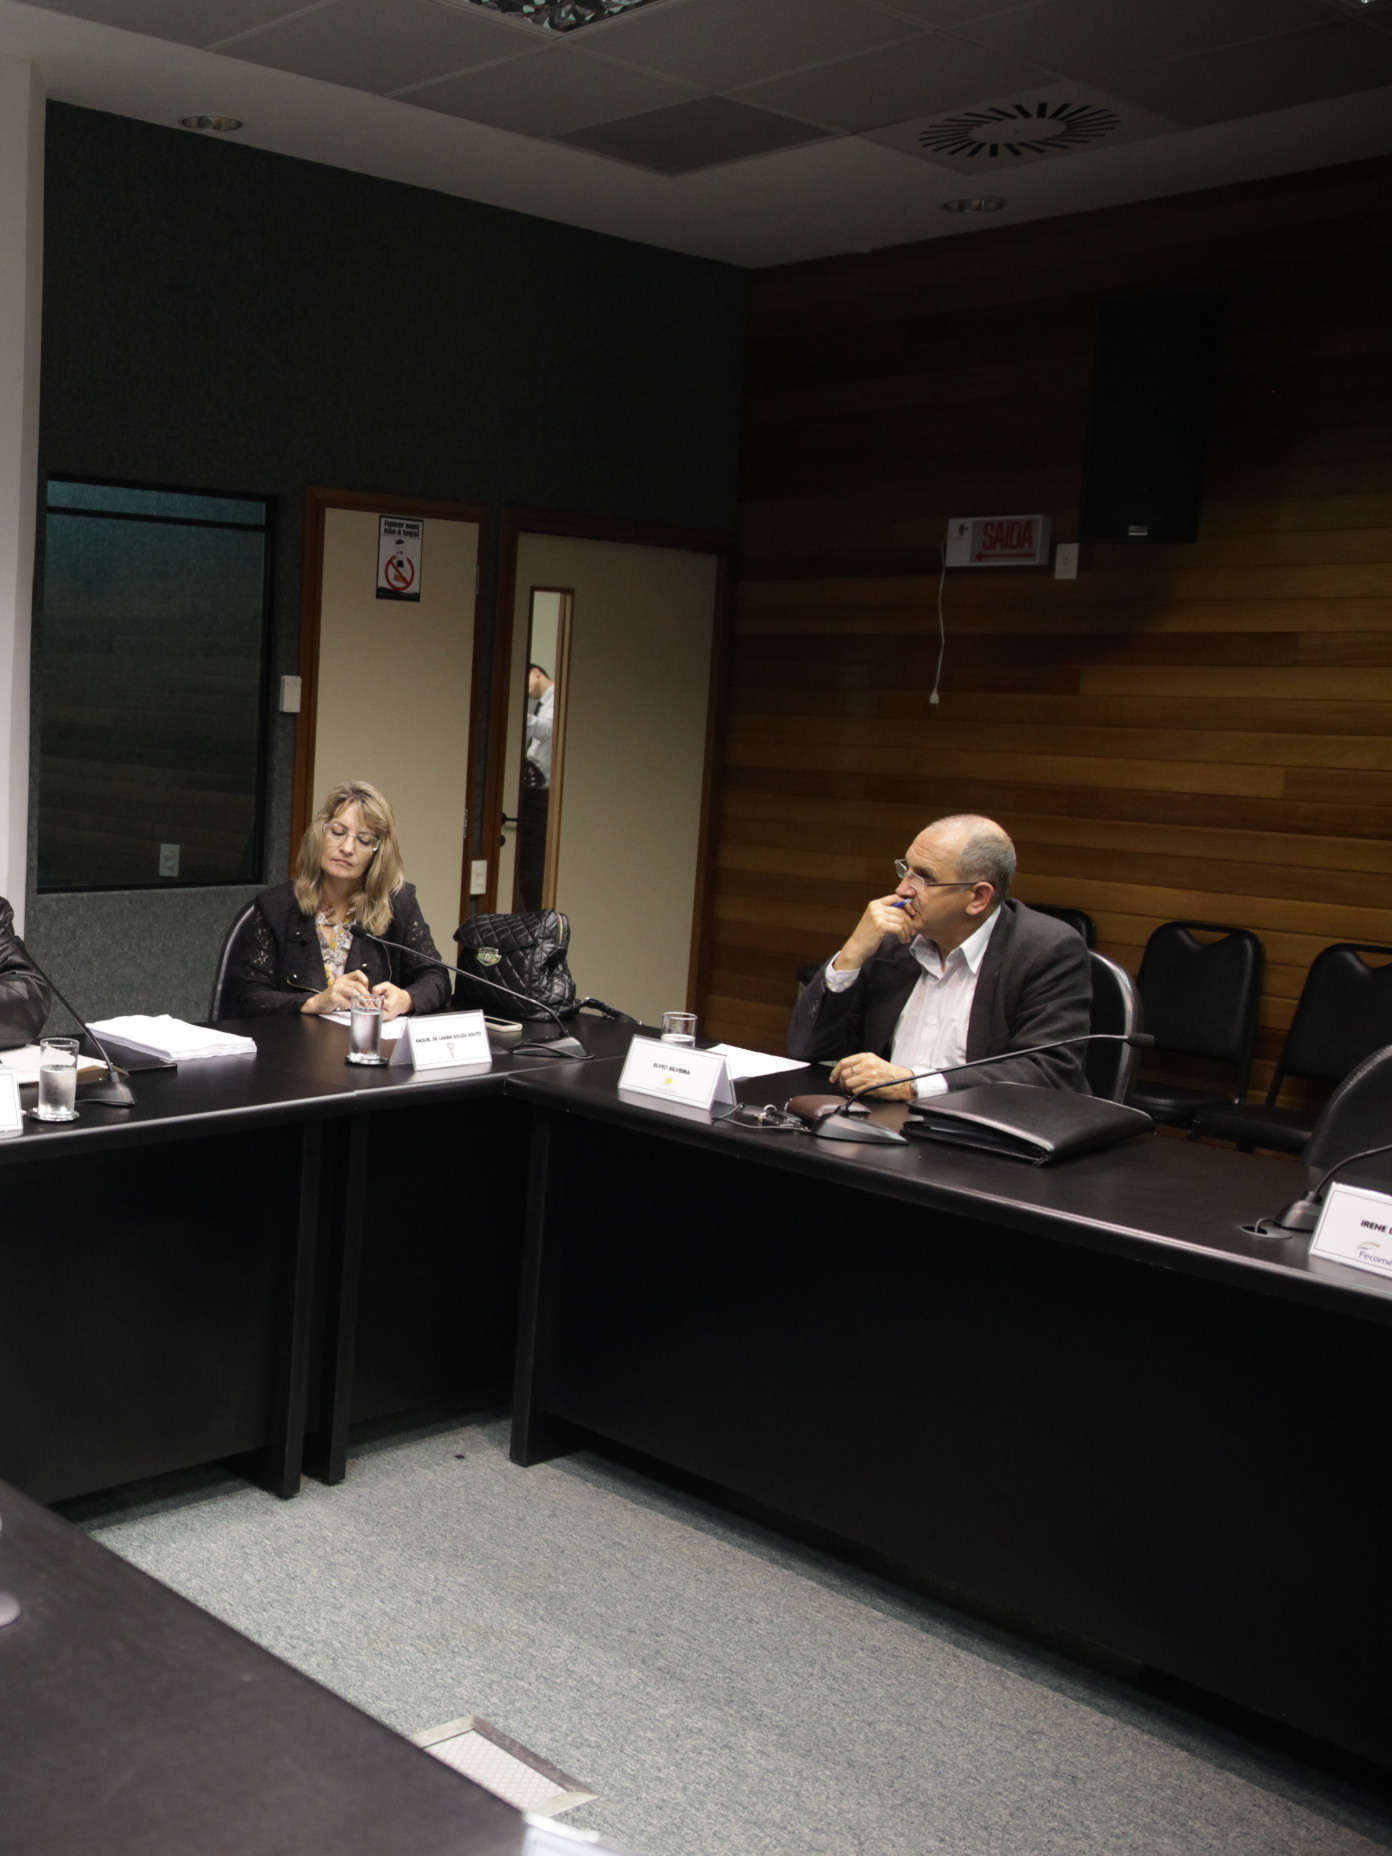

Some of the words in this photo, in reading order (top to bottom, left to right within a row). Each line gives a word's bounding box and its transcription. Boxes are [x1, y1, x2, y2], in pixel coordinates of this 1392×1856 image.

[384, 520, 404, 529] Fumar
[405, 522, 420, 530] aqui
[384, 527, 396, 535] não
[402, 529, 420, 538] legal
[1360, 1219, 1387, 1233] IRENE
